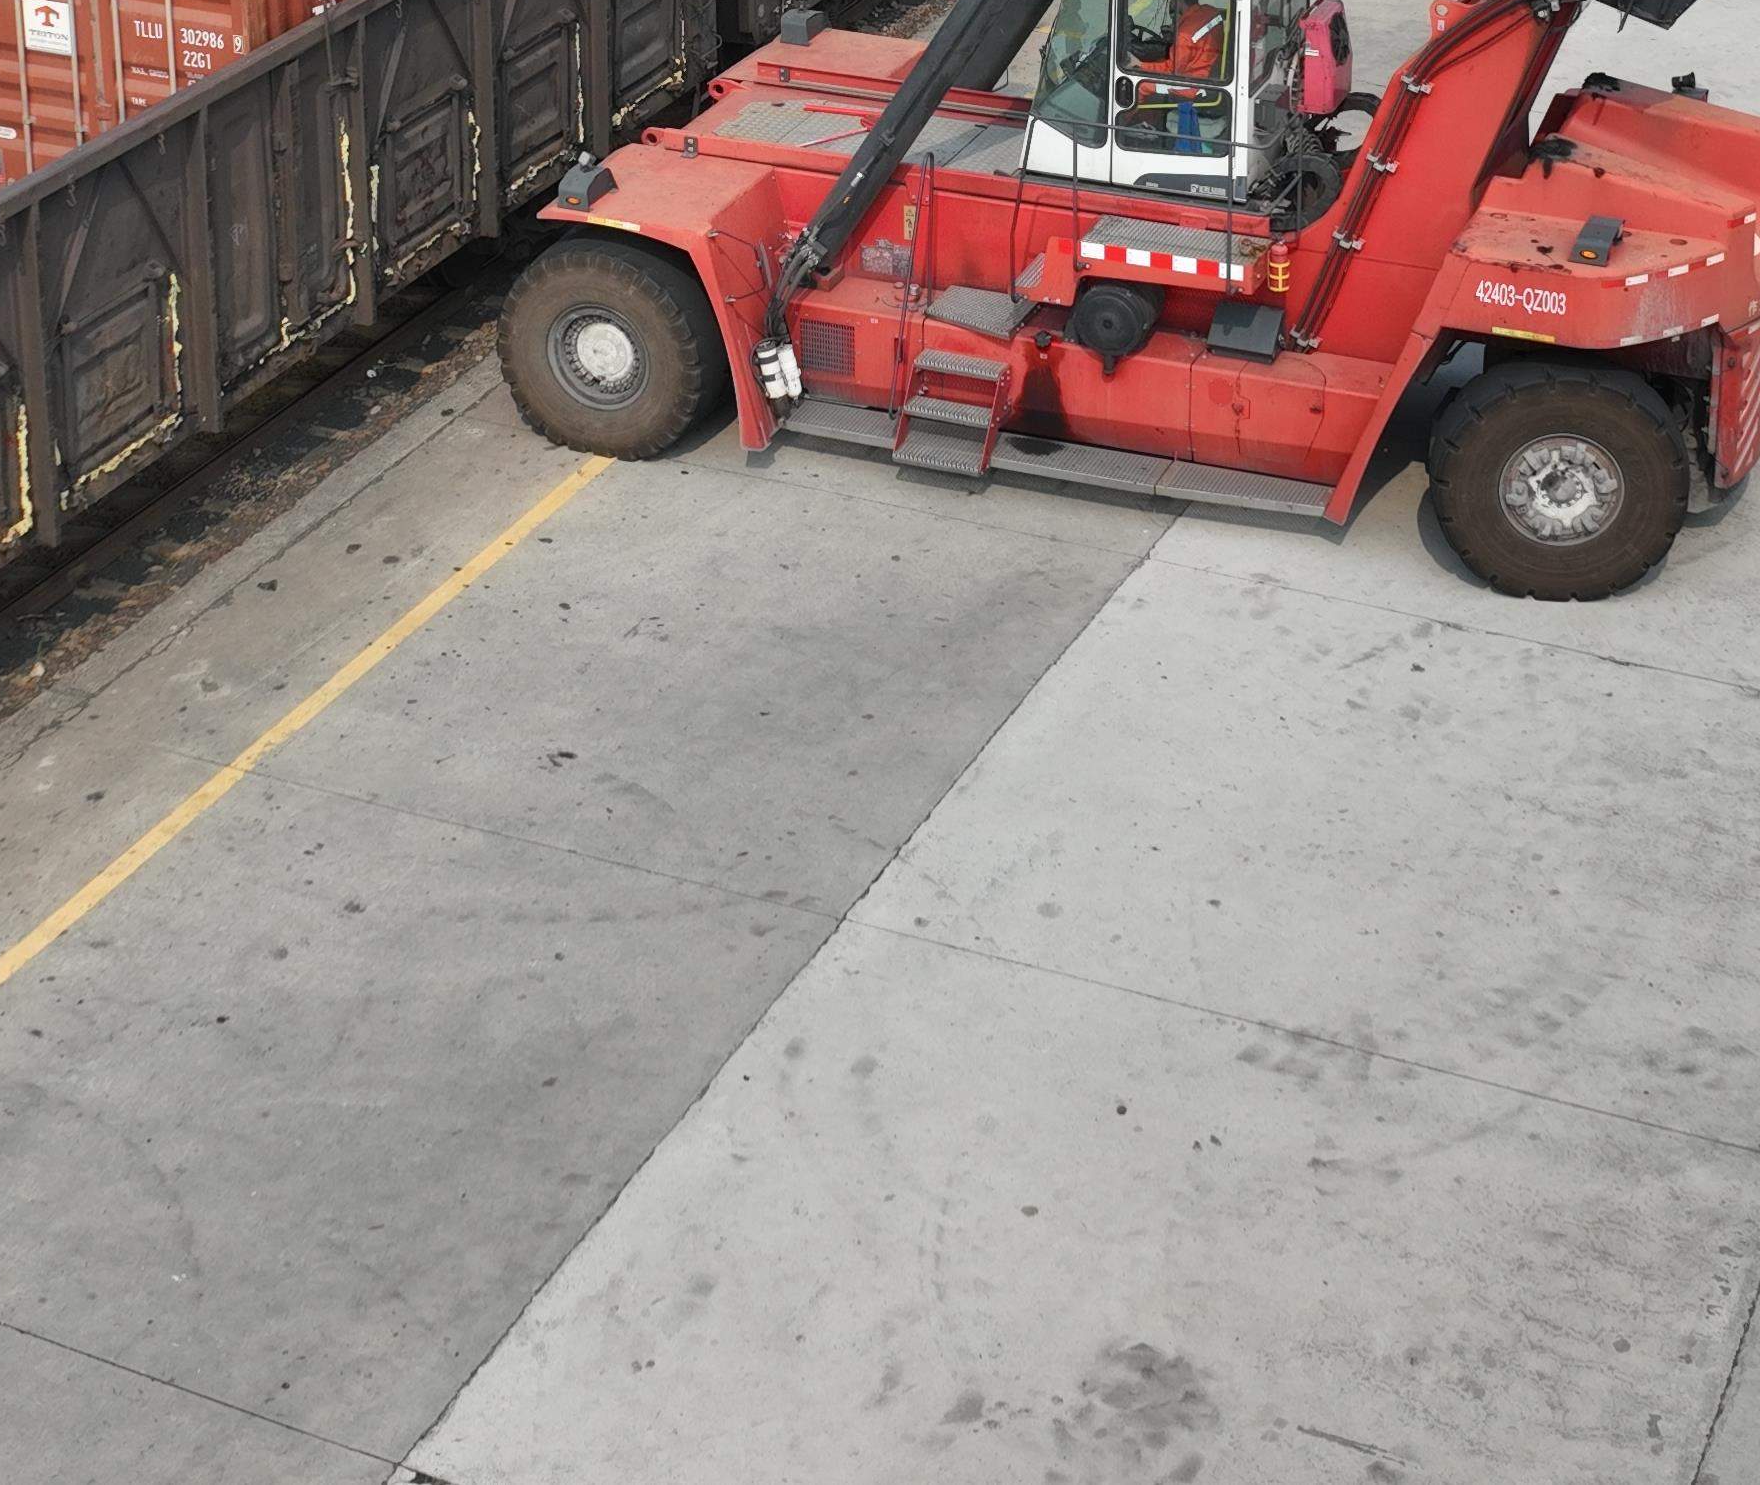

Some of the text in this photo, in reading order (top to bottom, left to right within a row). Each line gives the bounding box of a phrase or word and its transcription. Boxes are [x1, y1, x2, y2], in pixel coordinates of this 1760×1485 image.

[133, 20, 163, 39] TLLU
[180, 27, 224, 50] 302986
[183, 50, 212, 70] 22G1
[1475, 279, 1567, 316] 42403-QZ003
